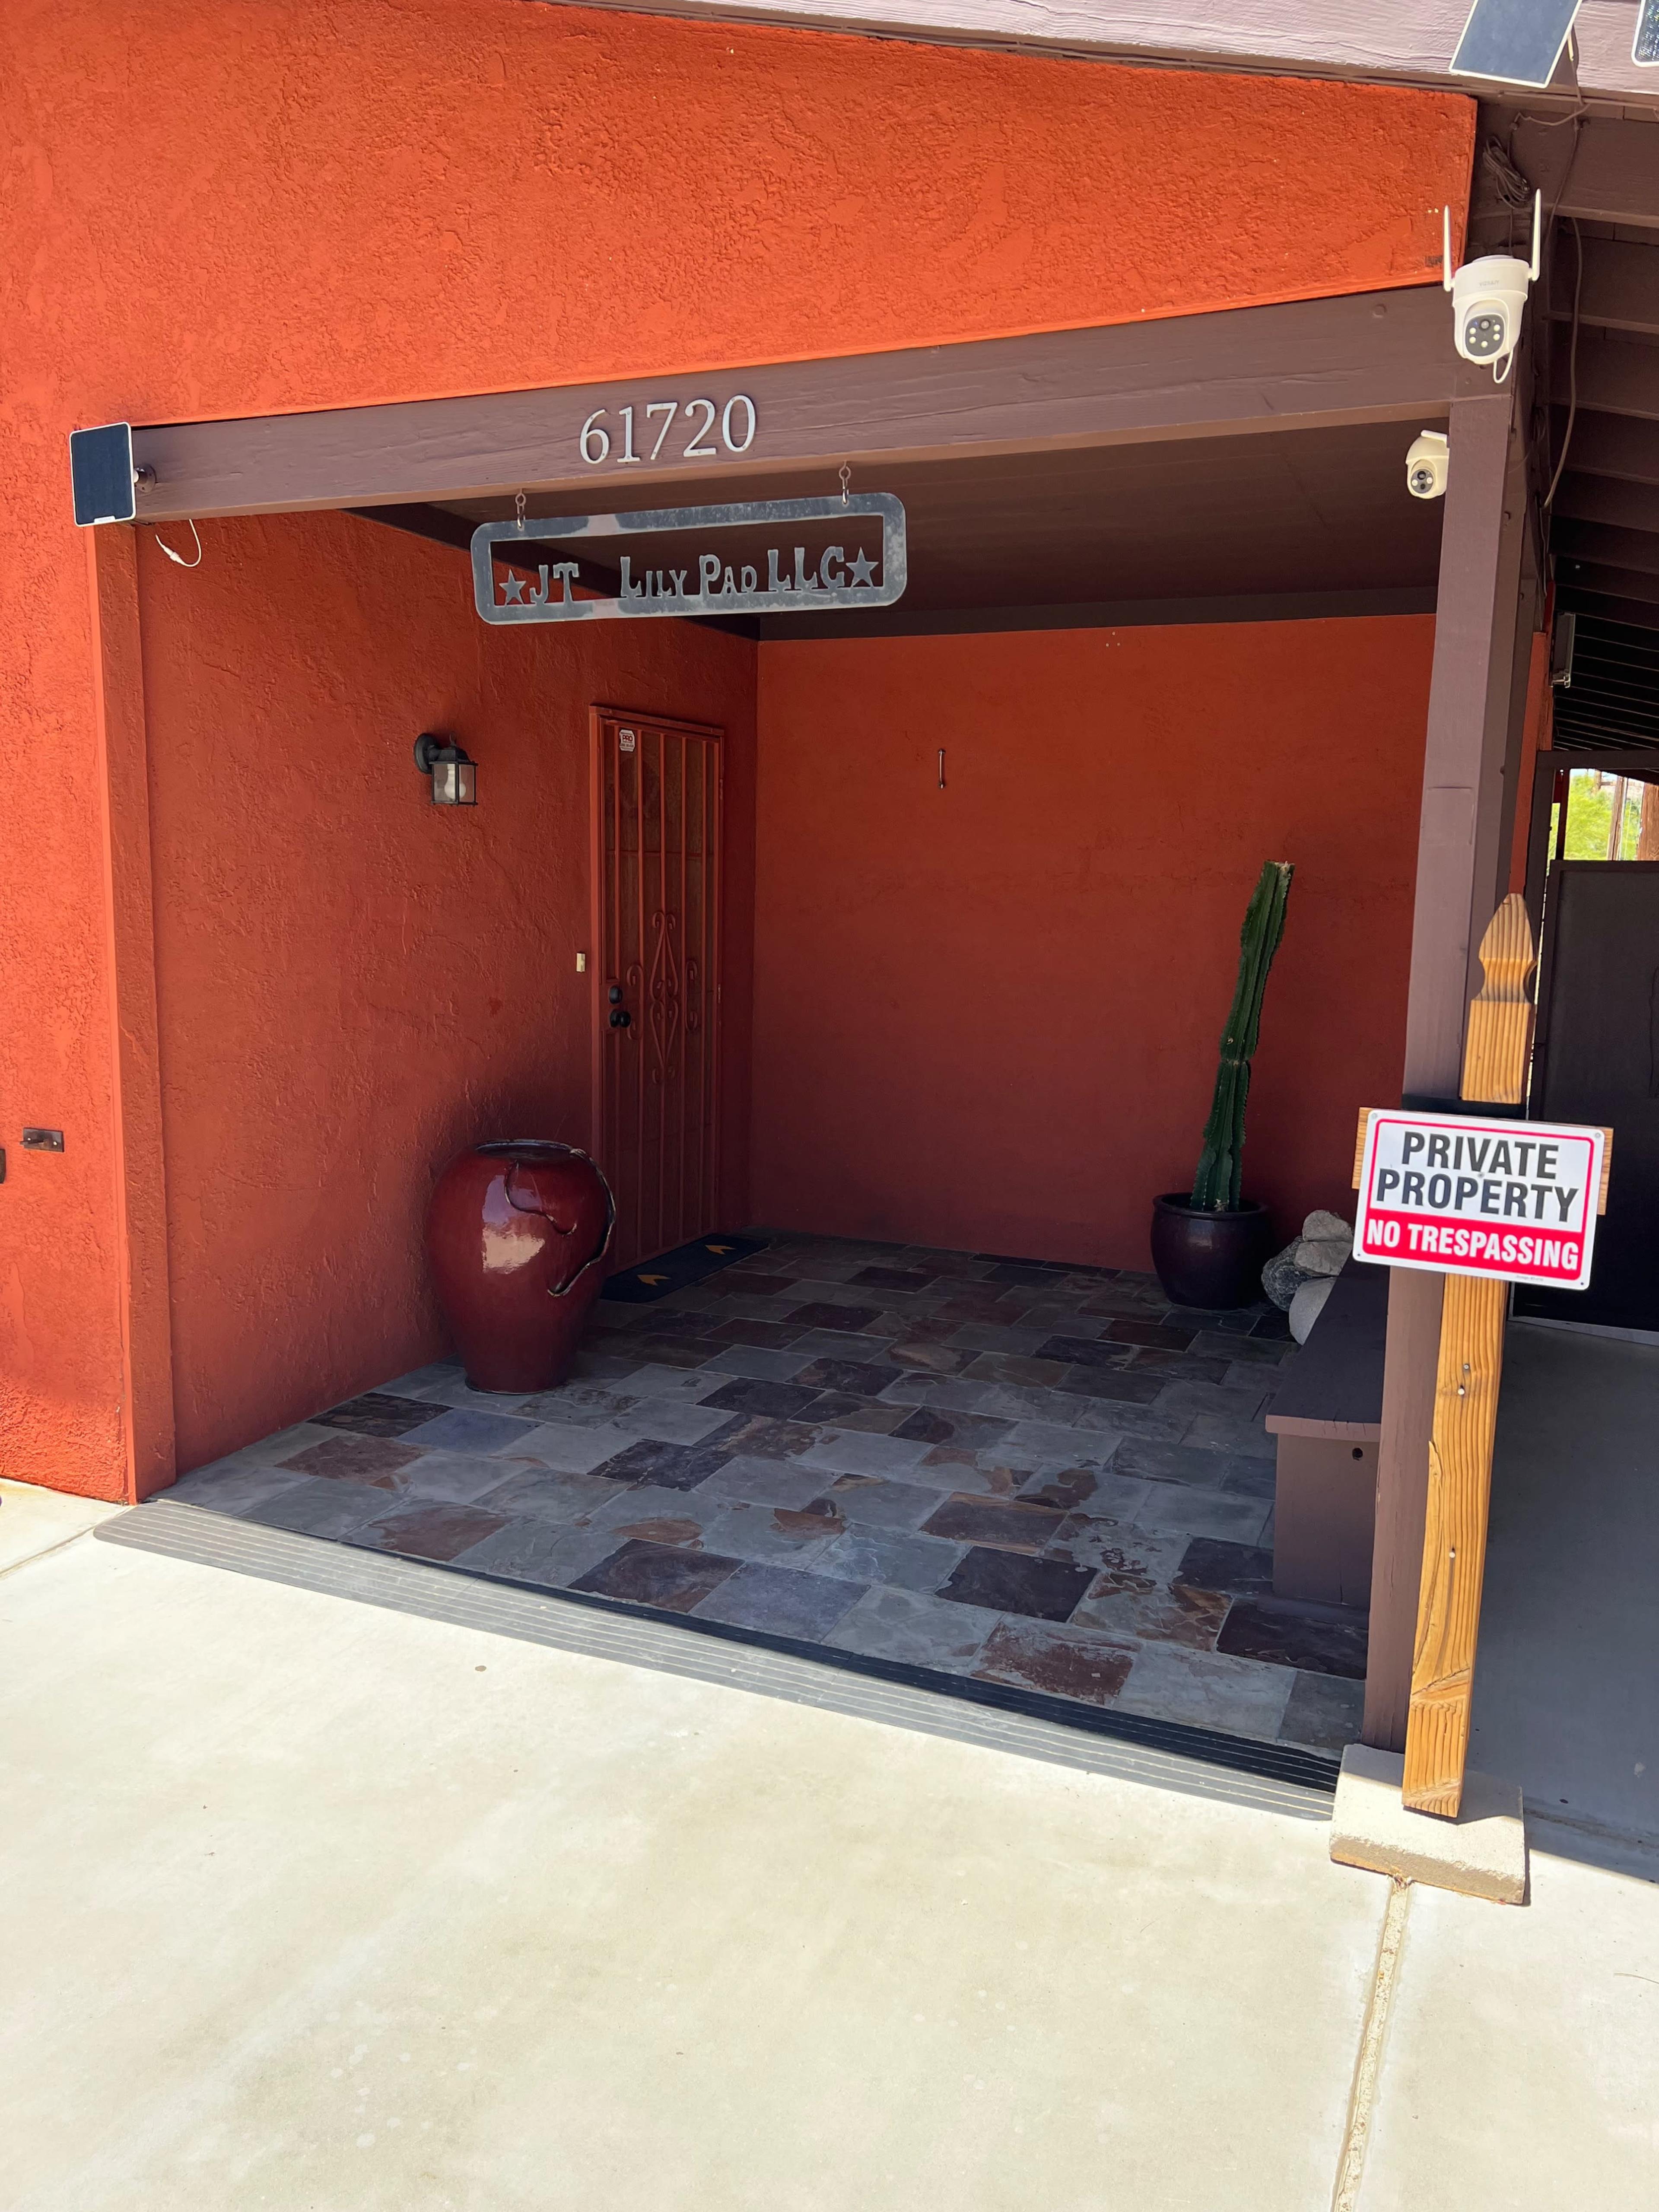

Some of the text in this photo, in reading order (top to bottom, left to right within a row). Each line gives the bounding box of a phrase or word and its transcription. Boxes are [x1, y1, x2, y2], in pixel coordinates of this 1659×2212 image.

[580, 395, 756, 464] 61720
[529, 562, 580, 604] JT
[767, 546, 845, 592] LLC
[1402, 1131, 1559, 1179] PRIVATE
[1376, 1168, 1579, 1223] PROPERTY
[1366, 1220, 1579, 1270] NO TRESPASSING
